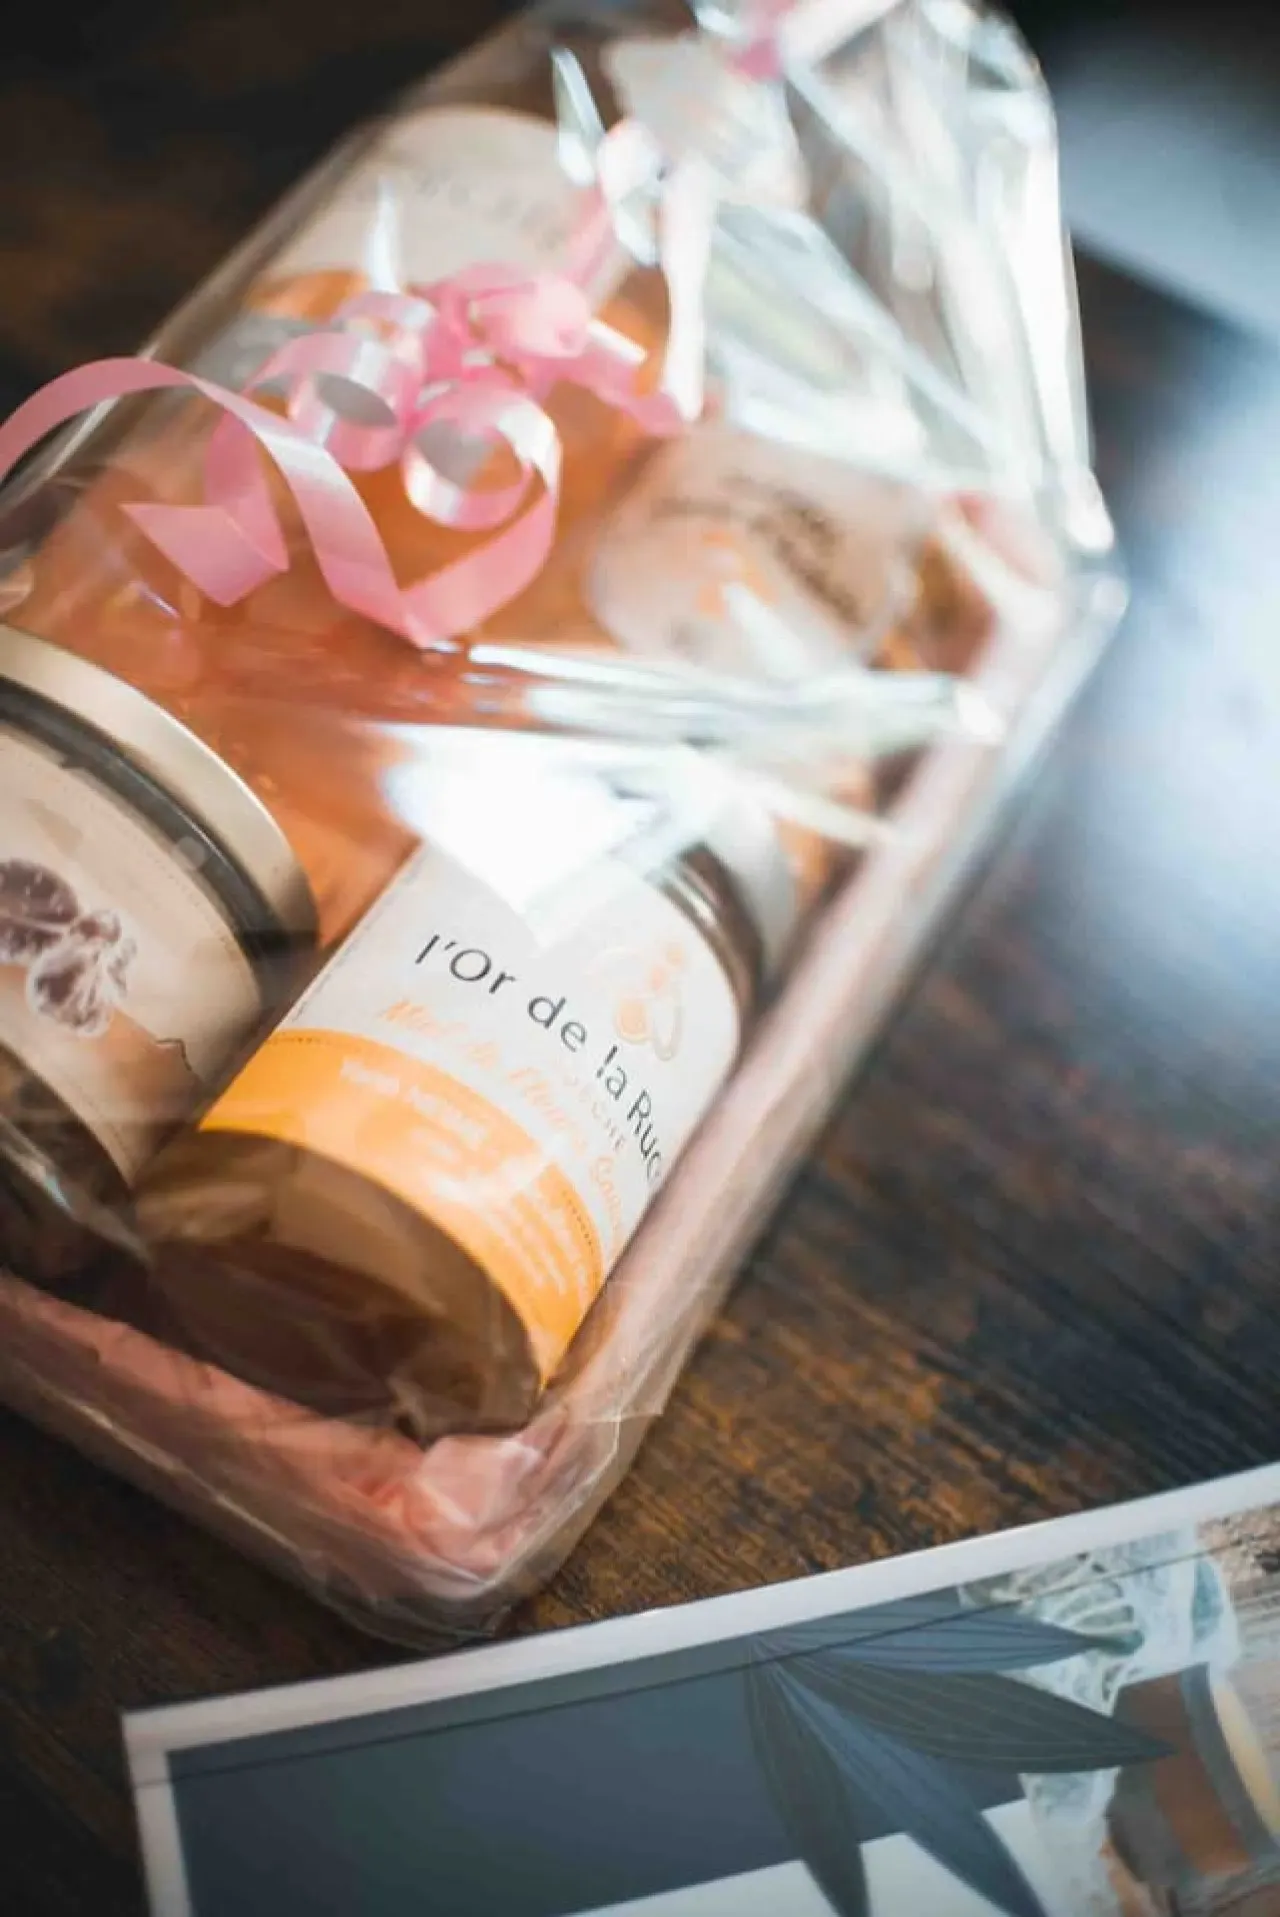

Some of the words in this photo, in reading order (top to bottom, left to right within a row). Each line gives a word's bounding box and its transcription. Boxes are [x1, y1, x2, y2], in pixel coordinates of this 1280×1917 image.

[414, 933, 516, 995] l'Or
[526, 996, 588, 1053] de
[596, 1044, 628, 1101] la
